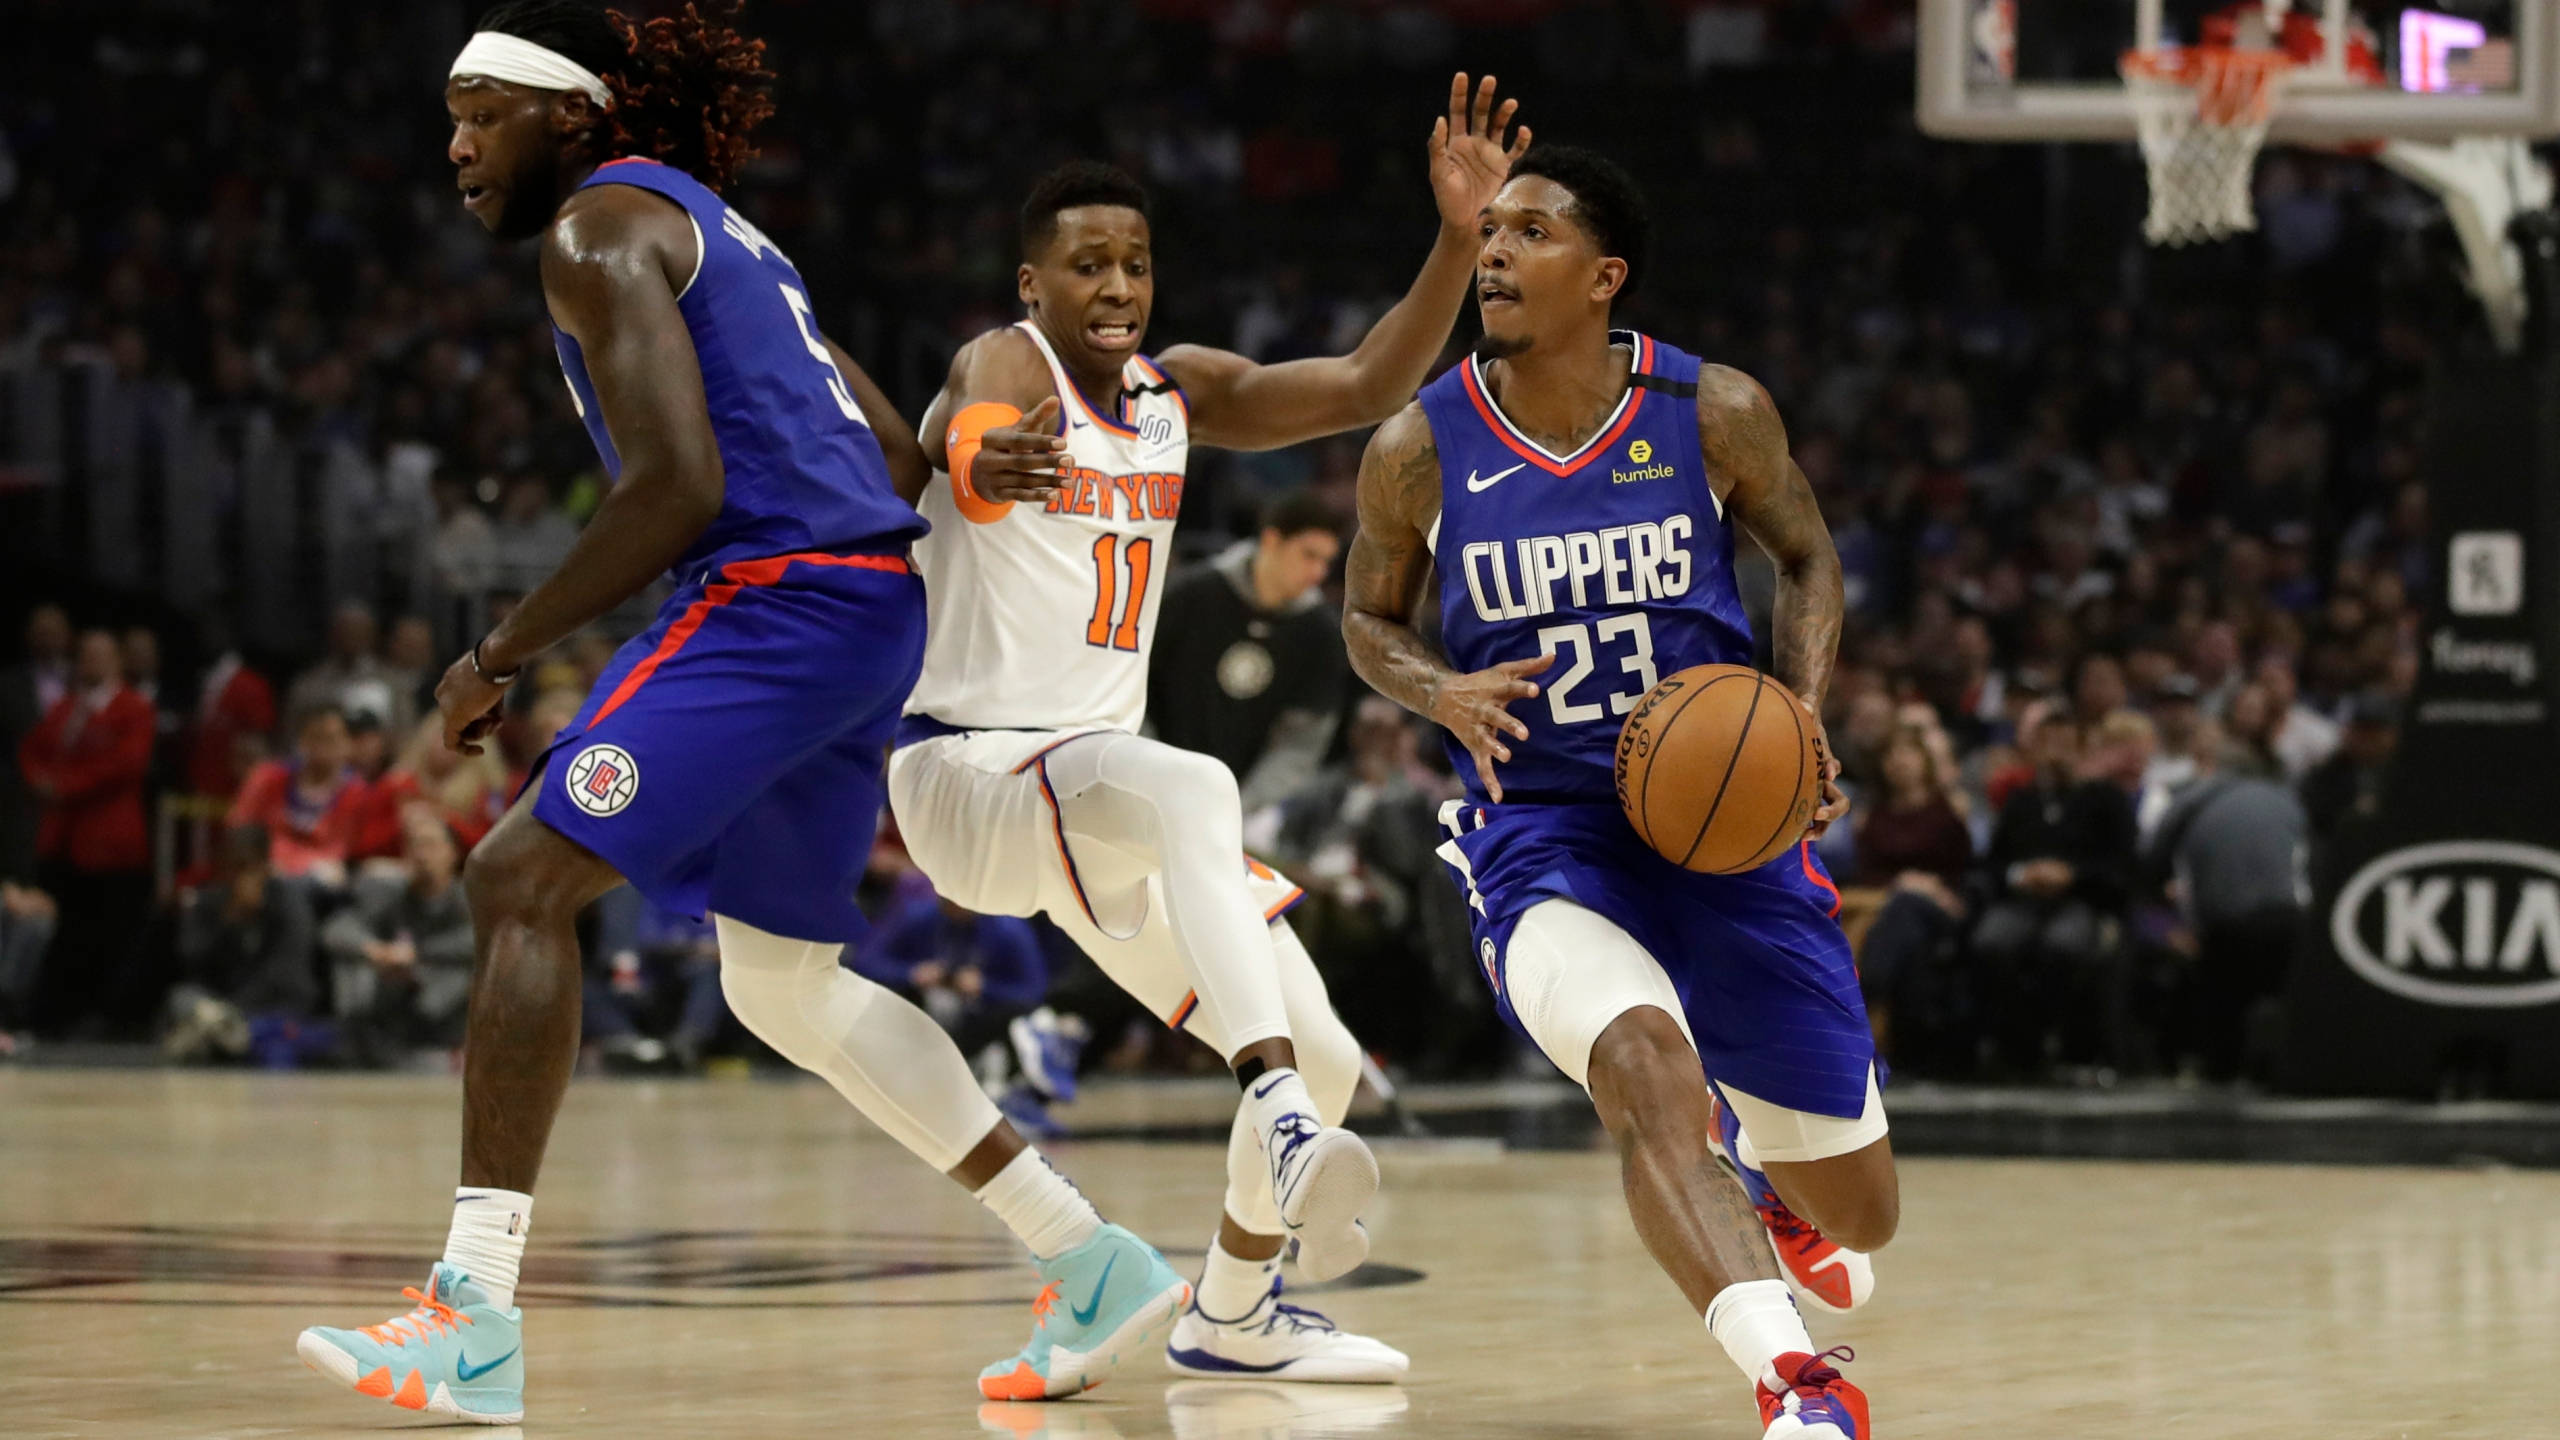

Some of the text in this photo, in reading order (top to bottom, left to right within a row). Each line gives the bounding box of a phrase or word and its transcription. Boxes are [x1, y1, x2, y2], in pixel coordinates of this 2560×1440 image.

[779, 283, 870, 429] 5
[1045, 466, 1185, 521] NEW YOR
[1612, 464, 1674, 484] bumble
[1086, 532, 1153, 652] 11
[1462, 514, 1693, 622] CLIPPERS
[1537, 612, 1658, 725] 23
[1616, 681, 1685, 811] SPALDING
[2384, 876, 2560, 972] KIA
